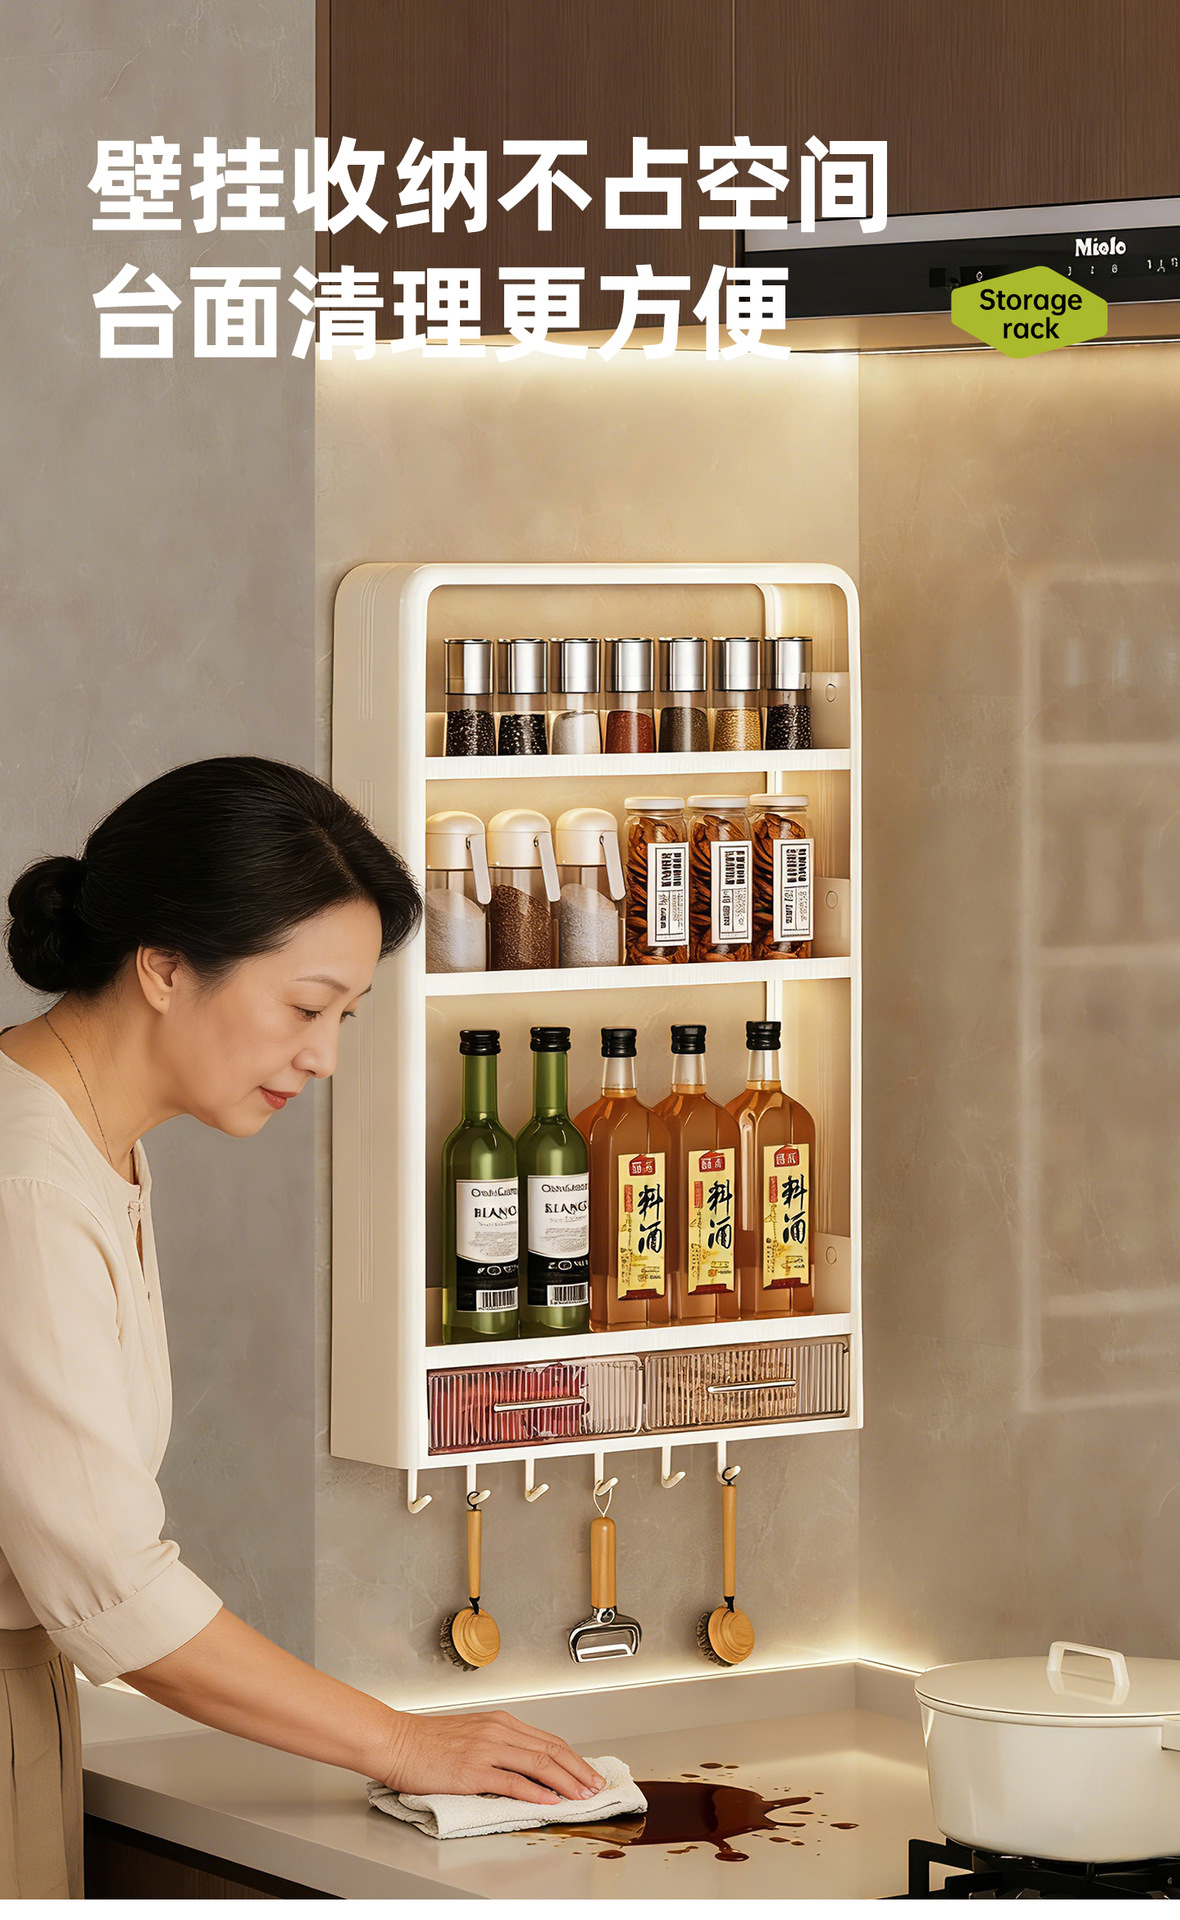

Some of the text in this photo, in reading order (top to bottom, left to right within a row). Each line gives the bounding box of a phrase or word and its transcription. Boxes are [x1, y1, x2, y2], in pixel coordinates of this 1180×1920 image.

[637, 1183, 664, 1254] 料酒
[706, 1179, 733, 1250] 料酒
[781, 1173, 808, 1244] 料酒
